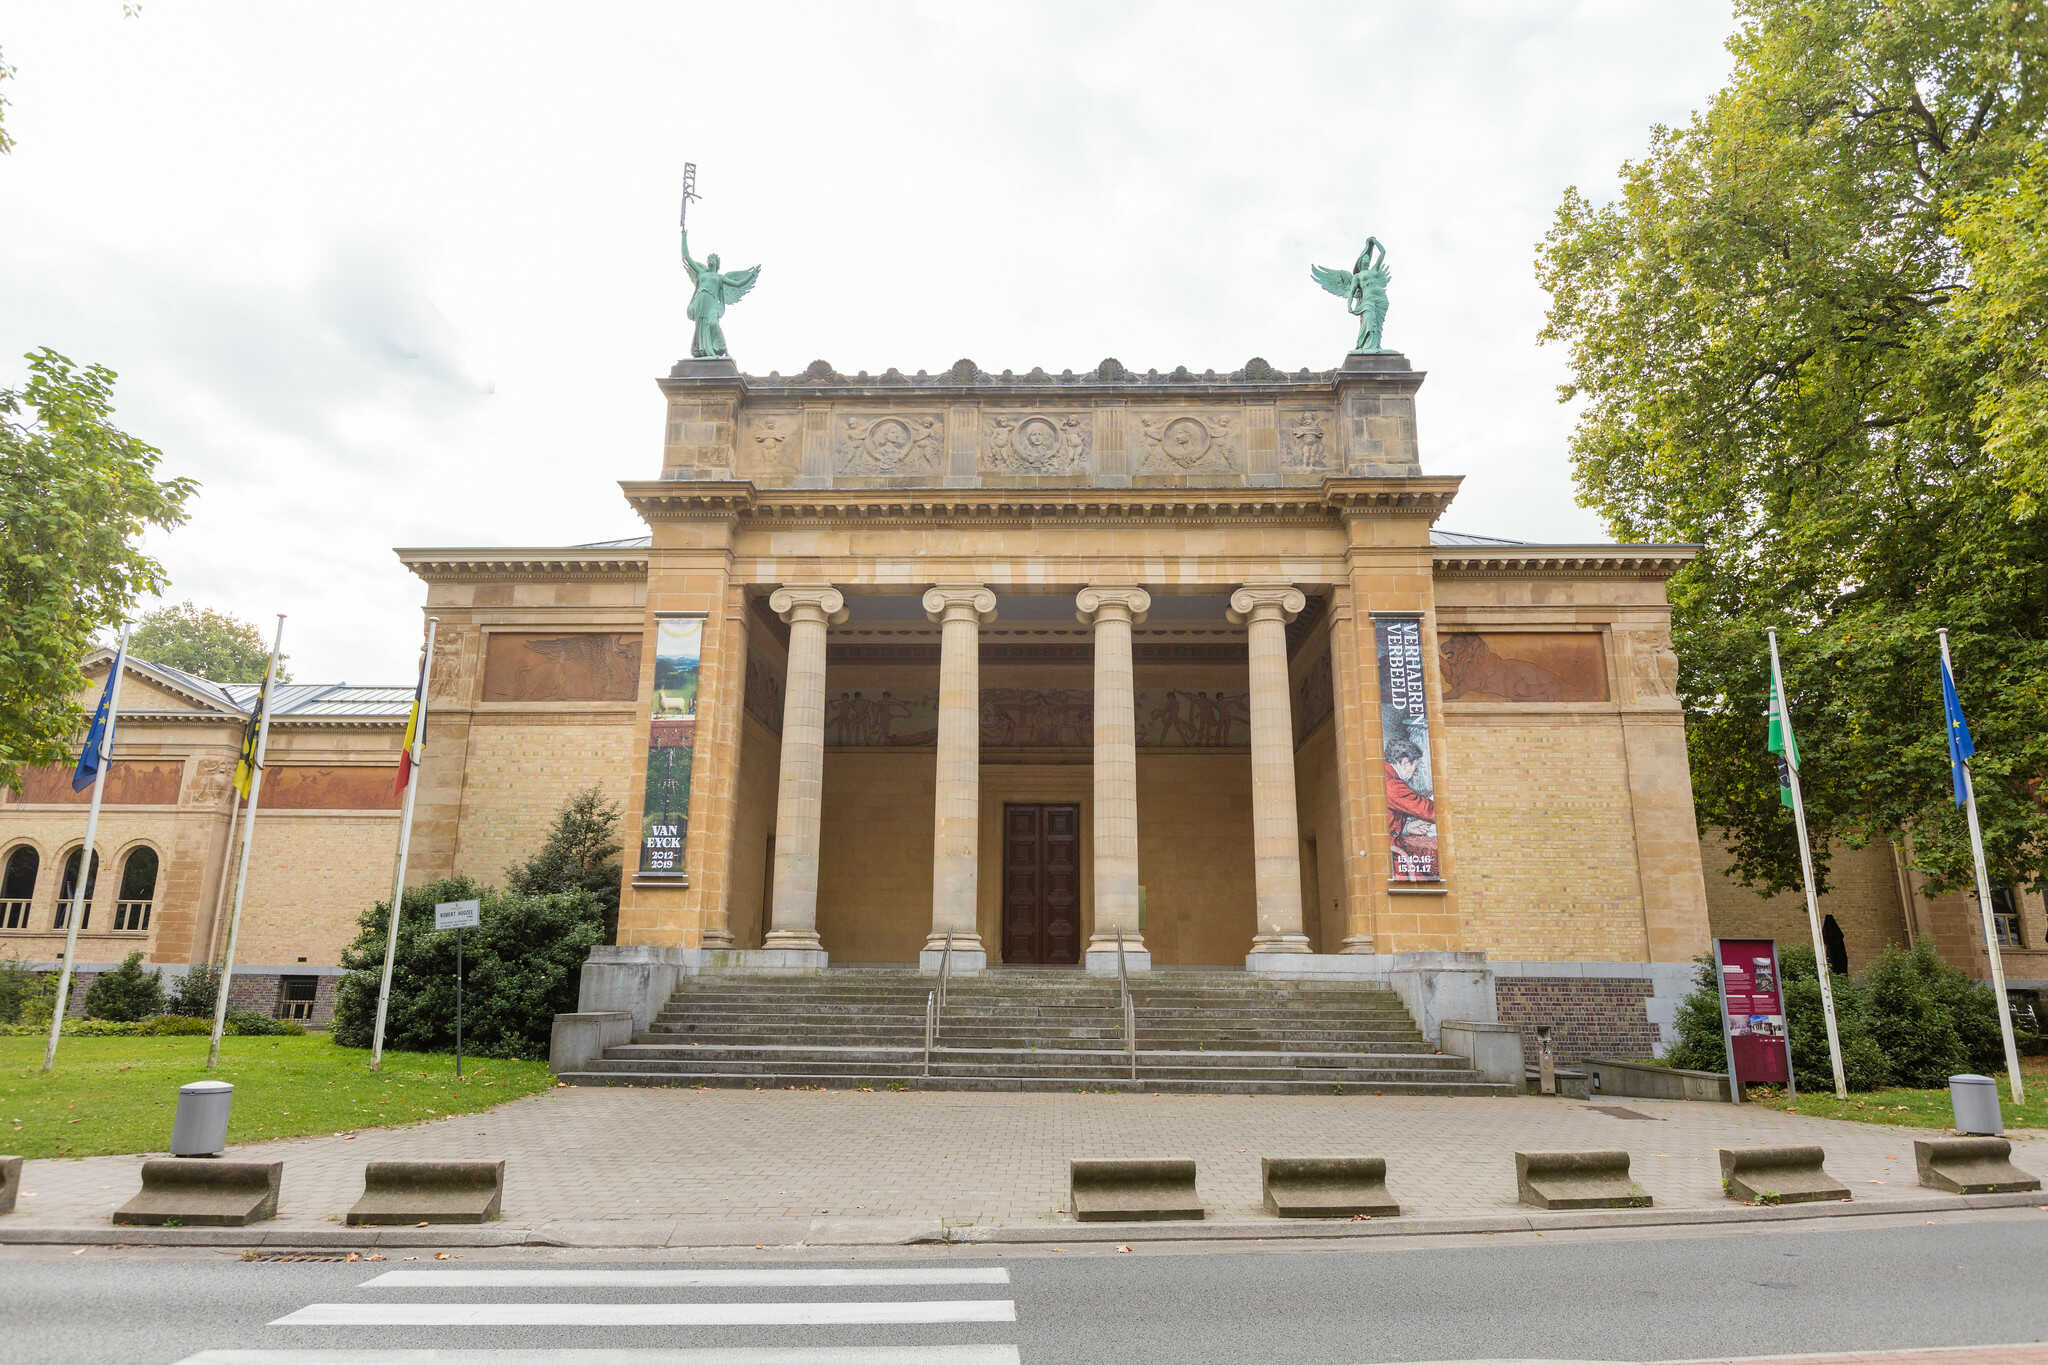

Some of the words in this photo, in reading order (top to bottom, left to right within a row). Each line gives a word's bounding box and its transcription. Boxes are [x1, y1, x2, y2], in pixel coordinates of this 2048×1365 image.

[1387, 623, 1407, 710] VERBEELD
[1403, 623, 1425, 725] VERHAEREN
[652, 825, 678, 836] VAN
[647, 837, 681, 848] EYCK
[651, 851, 678, 860] 2012-
[651, 860, 673, 869] 2019
[1398, 864, 1431, 872] 15.01.17
